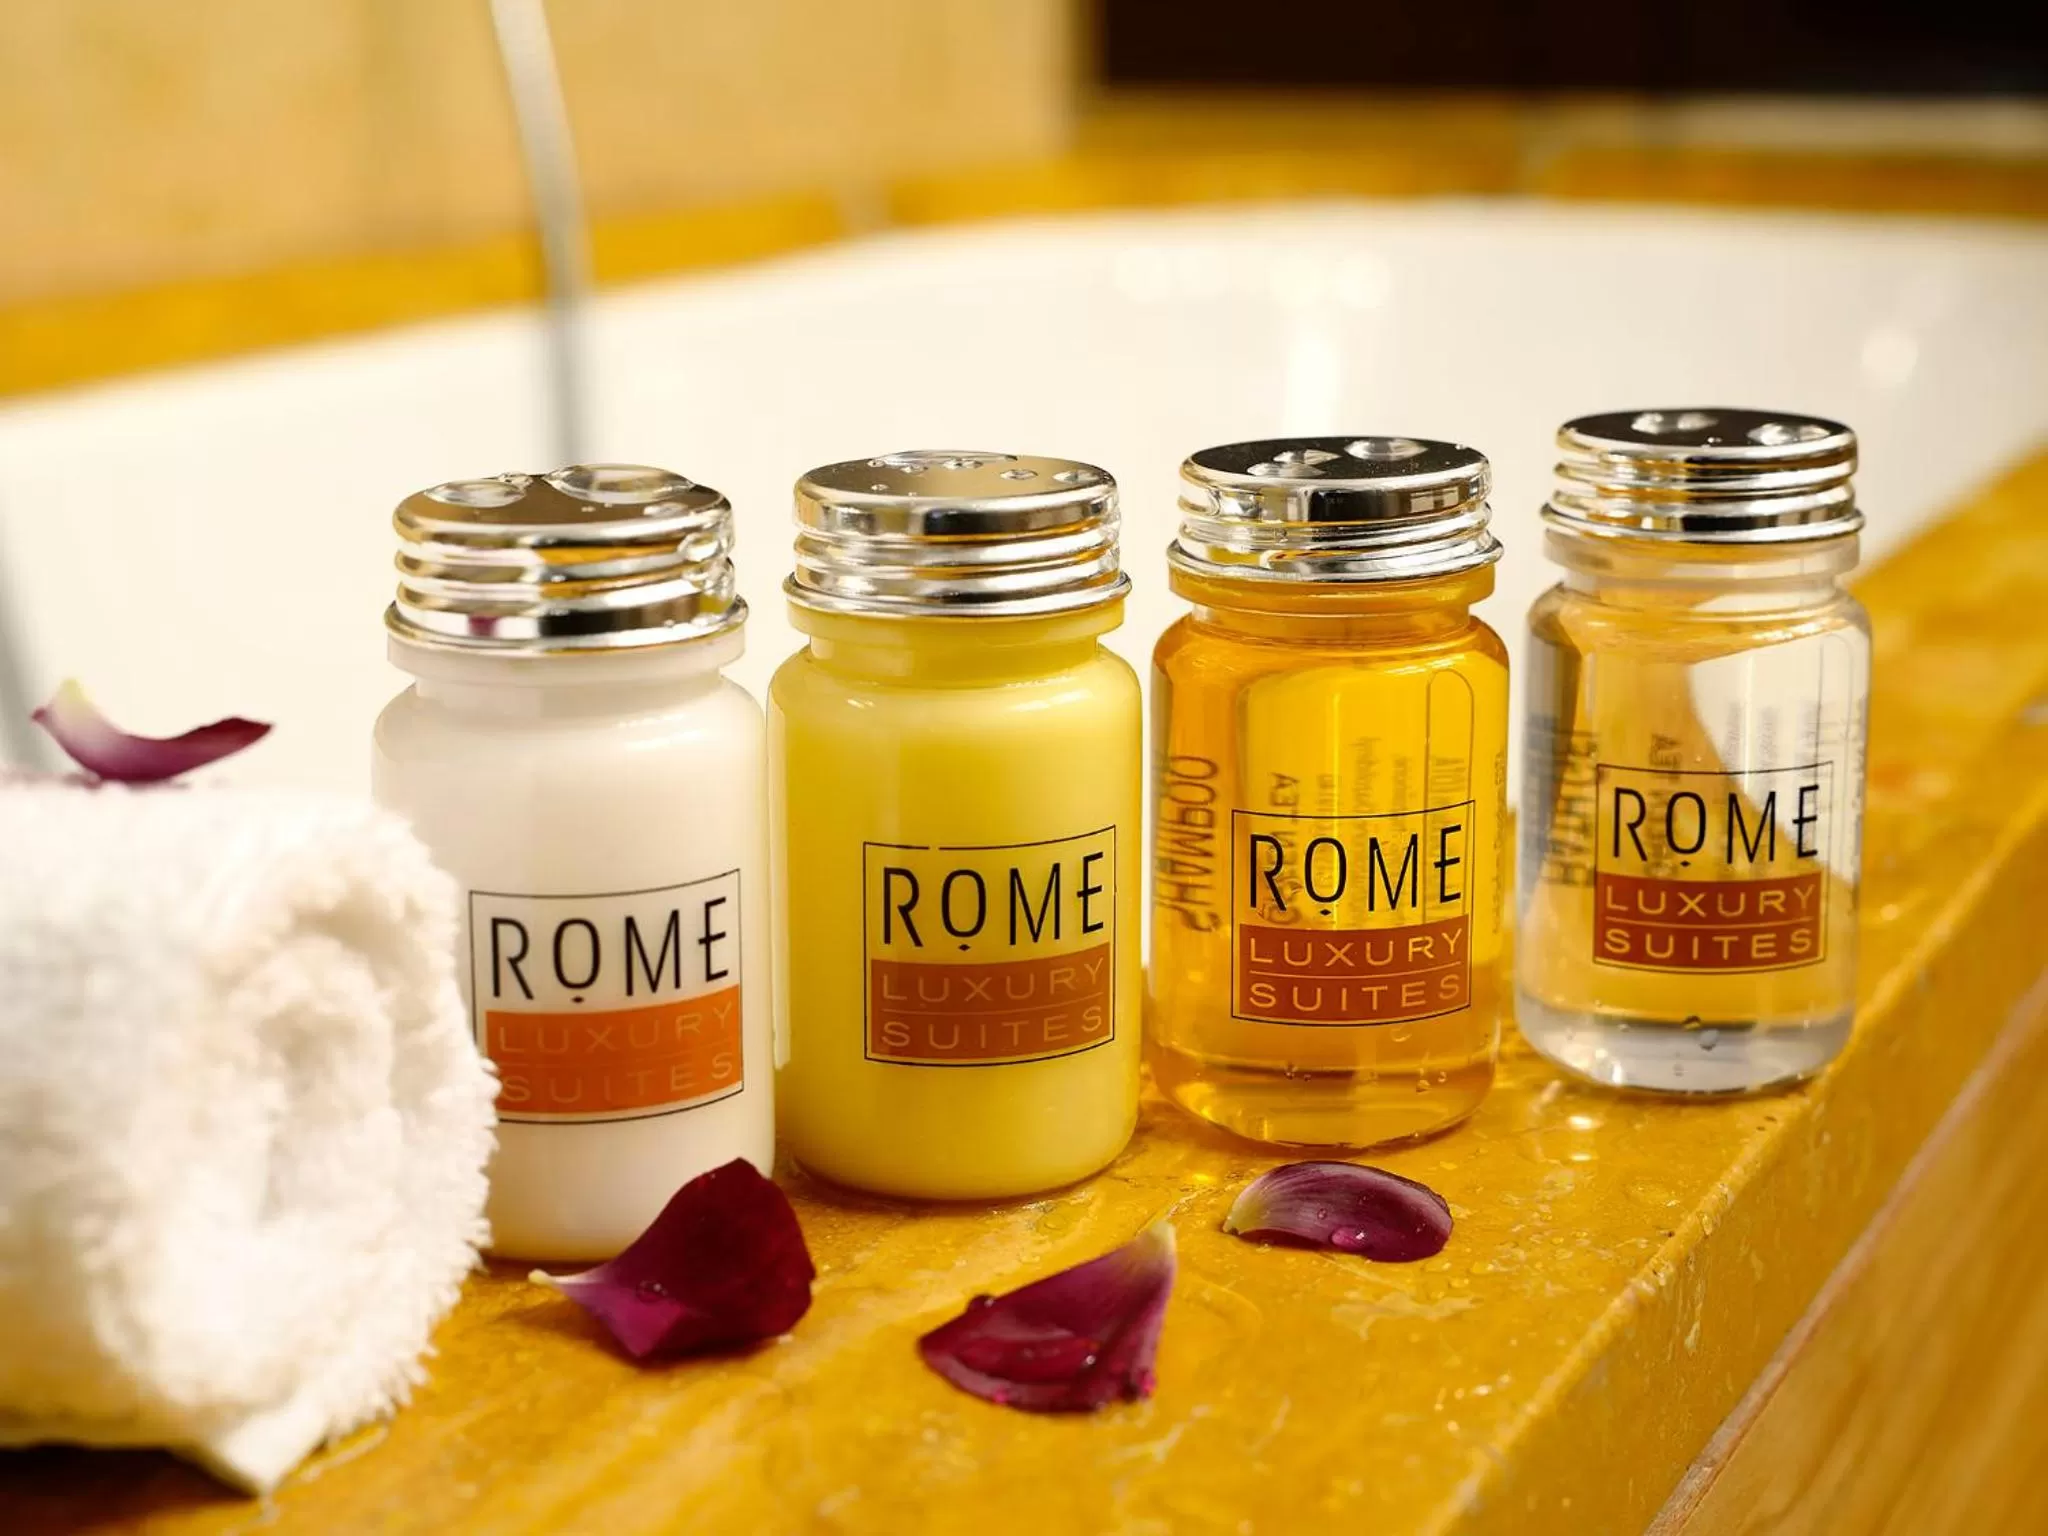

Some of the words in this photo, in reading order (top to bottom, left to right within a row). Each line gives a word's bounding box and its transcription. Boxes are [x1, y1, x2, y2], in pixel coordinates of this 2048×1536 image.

[1613, 784, 1820, 868] ROME
[1250, 824, 1462, 916] ROME
[883, 851, 1104, 951] ROME
[1605, 884, 1815, 917] LUXURY
[490, 896, 729, 1003] ROME
[1249, 927, 1463, 967] LUXURY
[1604, 928, 1812, 960] SUITES
[881, 957, 1104, 1002] LUXURY
[1249, 974, 1461, 1012] SUITES
[500, 1001, 733, 1054] LUXURY
[881, 1005, 1102, 1050] SUITES
[500, 1052, 733, 1103] SUITES
